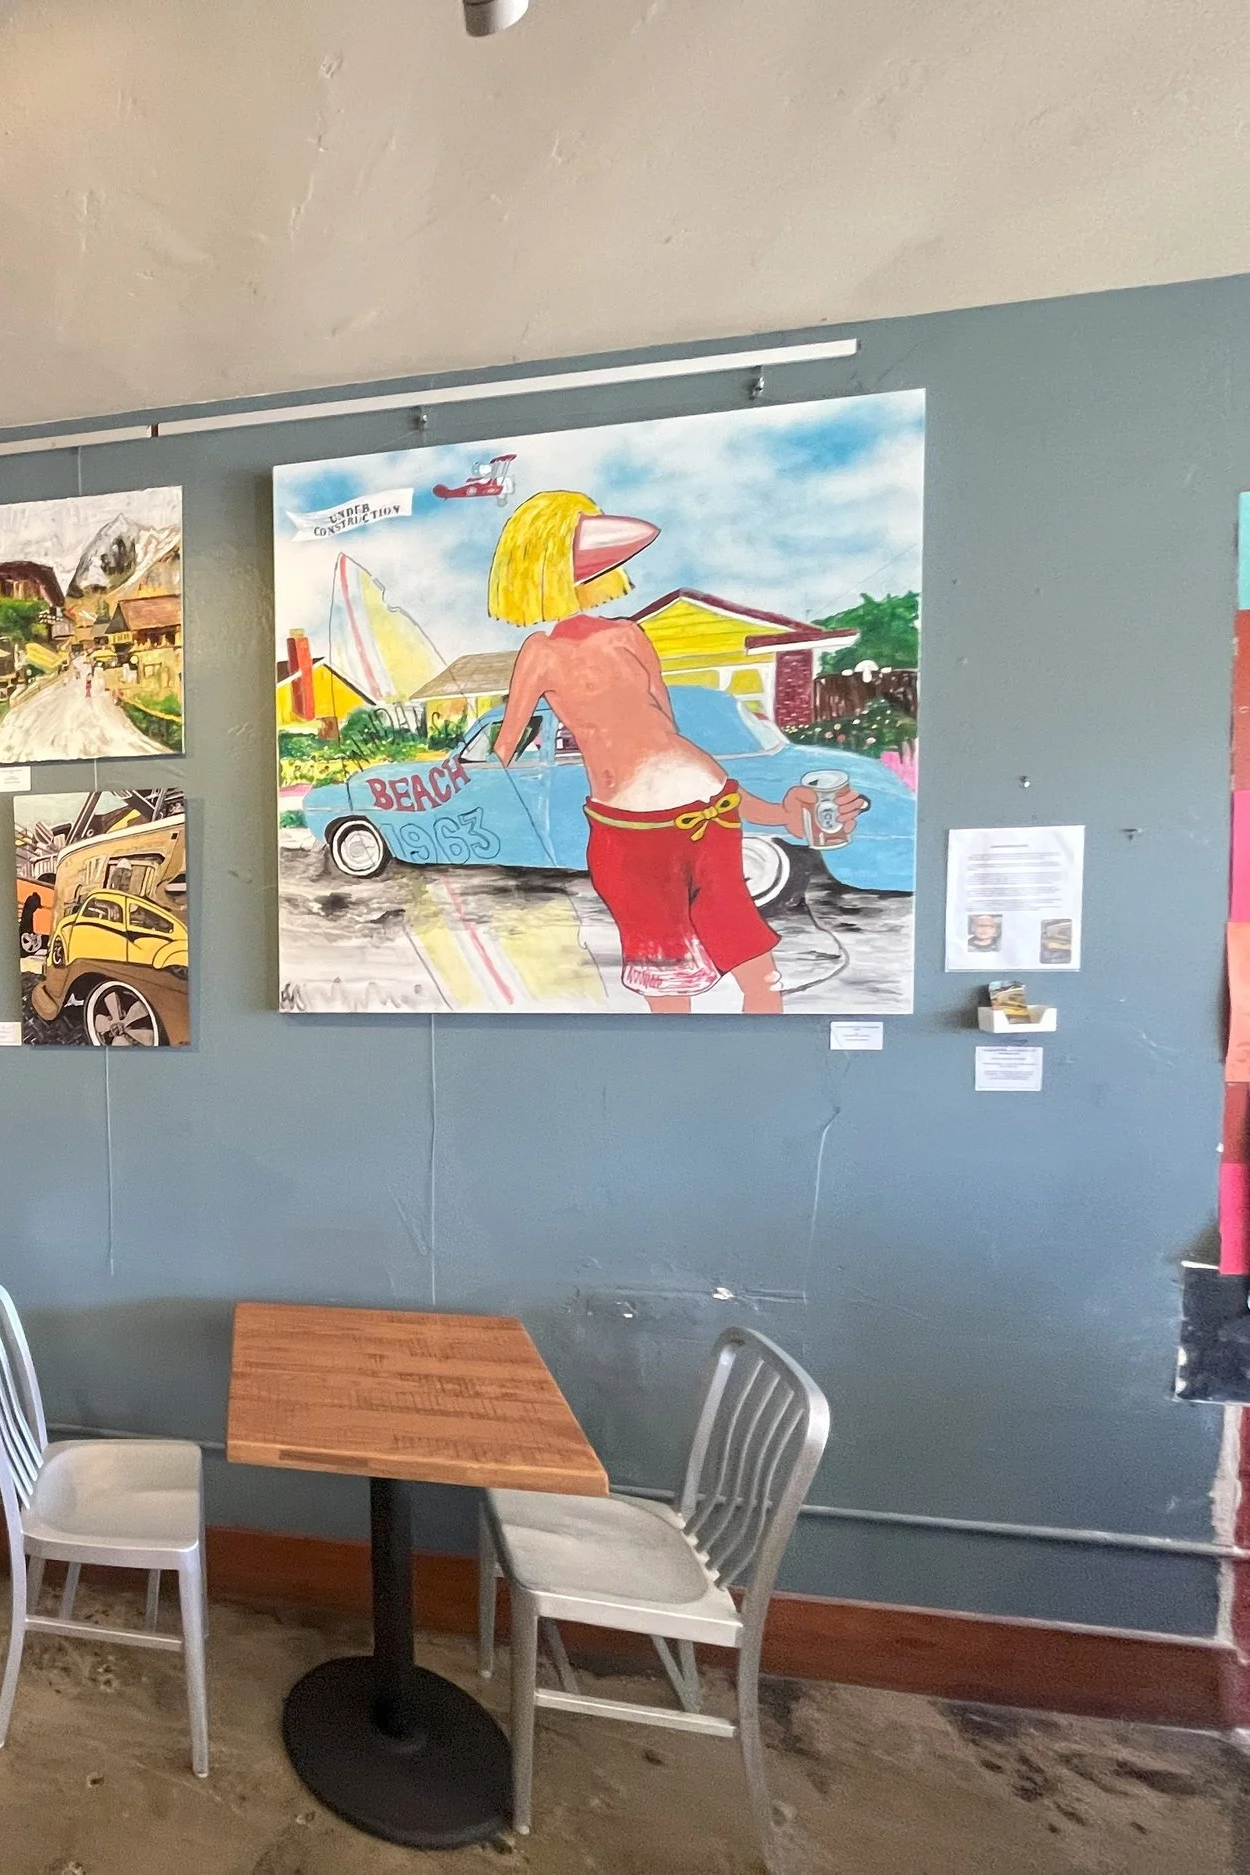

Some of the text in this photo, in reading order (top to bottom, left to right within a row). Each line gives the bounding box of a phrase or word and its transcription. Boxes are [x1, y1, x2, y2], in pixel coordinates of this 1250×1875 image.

[313, 505, 400, 537] CONSTRUCTION
[367, 754, 471, 812] BEACH
[380, 806, 500, 865] 1963
